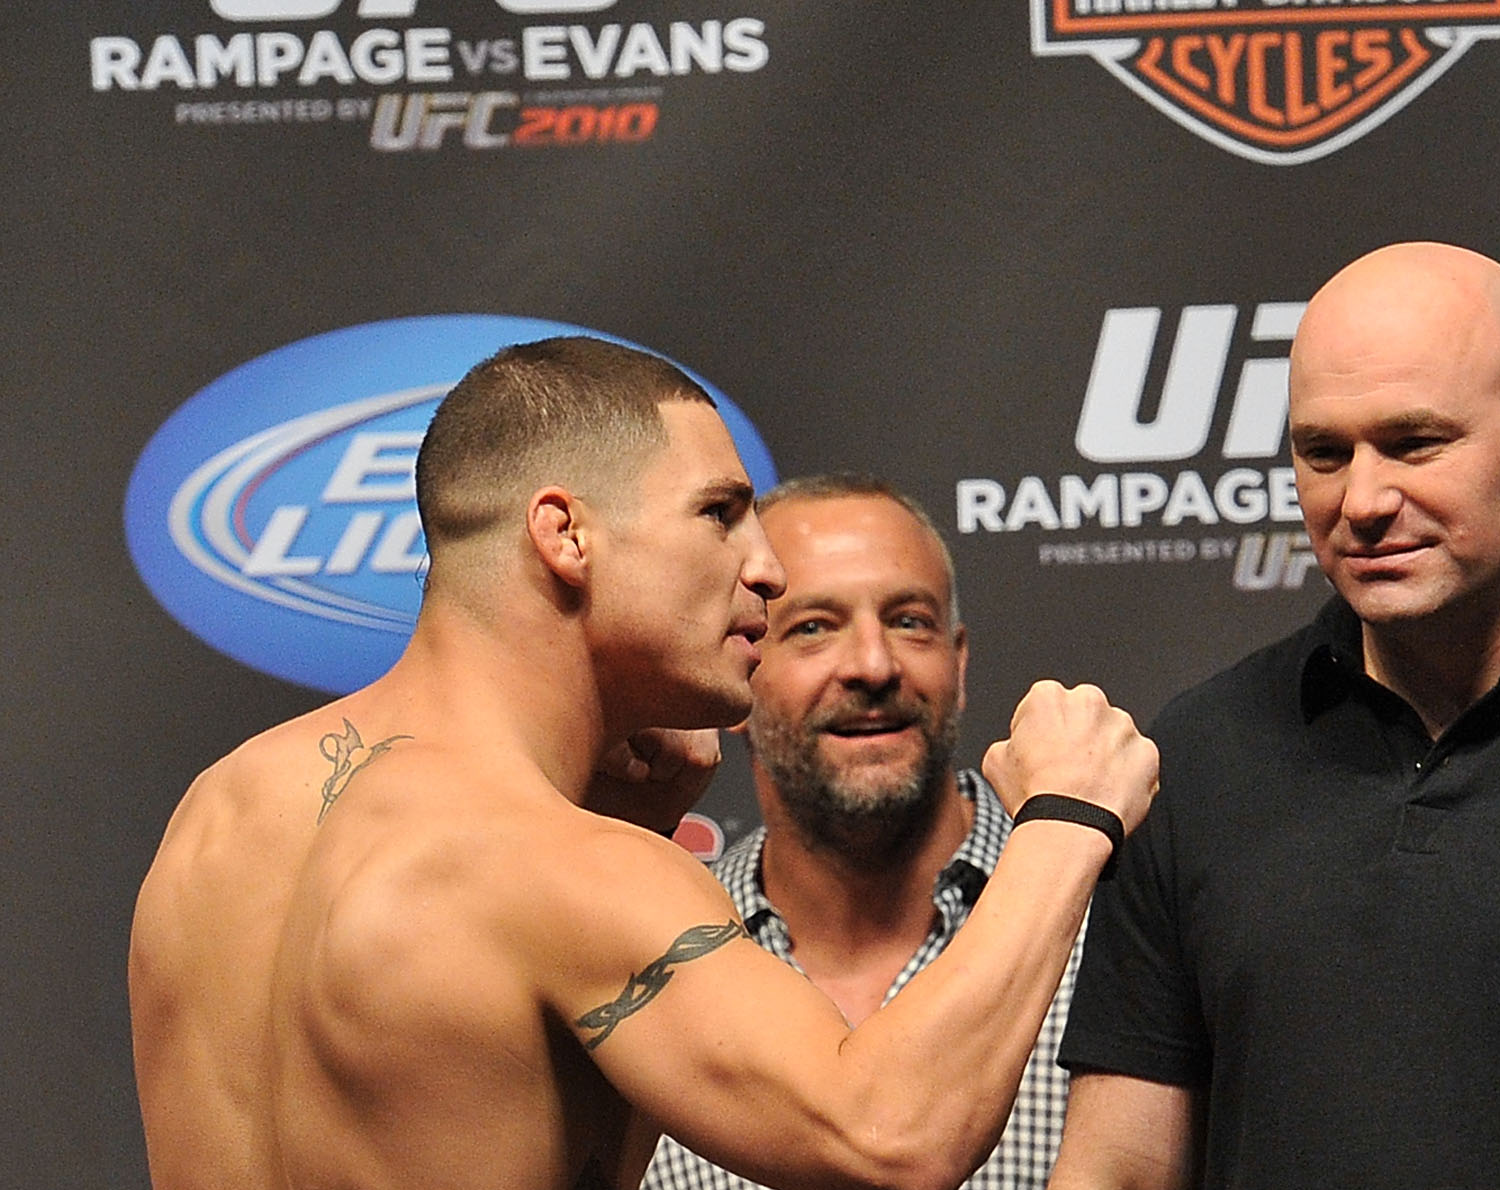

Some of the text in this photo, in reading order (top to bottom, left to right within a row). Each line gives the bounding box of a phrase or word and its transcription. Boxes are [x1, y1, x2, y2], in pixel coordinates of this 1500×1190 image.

[90, 28, 453, 90] RAMPAGE
[523, 17, 769, 81] EVANS
[1171, 28, 1394, 127] CYCLES
[174, 99, 334, 123] PRESENTED
[337, 97, 372, 119] BY
[370, 91, 519, 149] UFC
[513, 102, 659, 146] 2010
[1075, 302, 1308, 463] UF
[956, 467, 1304, 533] RAMPAGE
[1233, 532, 1318, 591] UF
